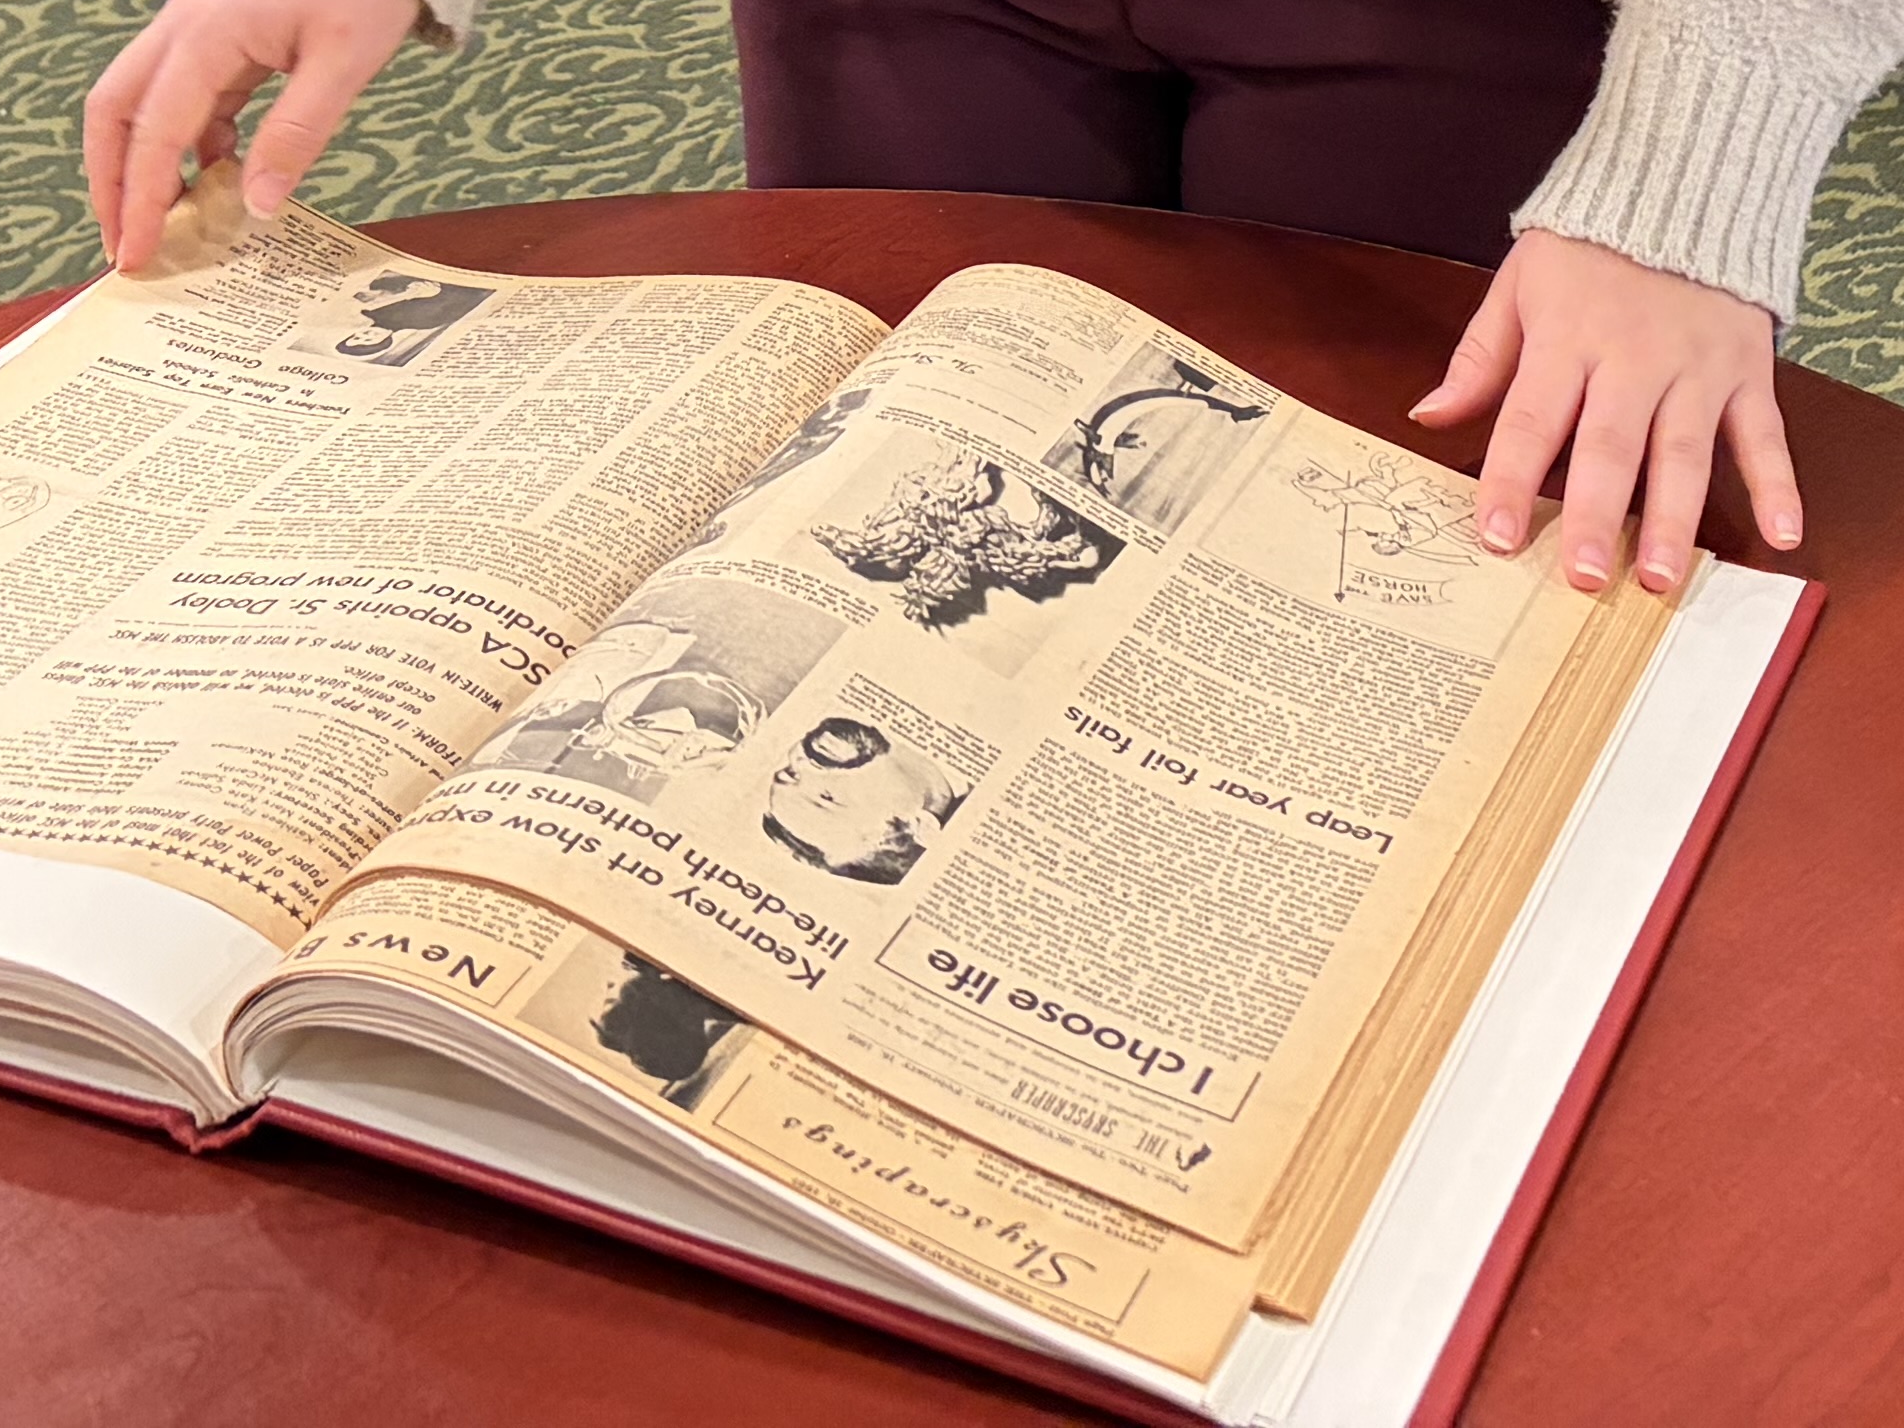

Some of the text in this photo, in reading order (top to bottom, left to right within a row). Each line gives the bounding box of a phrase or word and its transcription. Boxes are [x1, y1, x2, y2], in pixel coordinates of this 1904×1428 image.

[167, 339, 262, 369] Graduates
[97, 356, 156, 377] Salaries
[162, 359, 315, 397] In Catholic Schools
[163, 374, 191, 387] Top
[200, 383, 234, 396] Earn
[285, 400, 351, 415] Teachers
[1351, 570, 1427, 598] HORSE
[1344, 585, 1432, 605] SAVE THE
[172, 572, 577, 660] oordinator of new program
[169, 592, 552, 686] SCA appoints Sr. Dooley
[52, 660, 84, 670] will
[83, 664, 116, 674] PPP
[108, 630, 503, 713] WRITE-IN VOTE FOR PPP IS A VOTE TO ABOLISH THE MSC
[118, 666, 142, 676] the
[141, 668, 161, 677] of
[125, 680, 150, 690] the
[152, 681, 200, 691] abolish
[200, 682, 231, 692] will
[297, 674, 313, 684] is
[314, 676, 351, 690] slate
[344, 666, 436, 703] accept office.
[258, 683, 314, 698] elected,
[316, 691, 333, 702] is
[352, 684, 396, 703] entire
[331, 696, 365, 712] PPP
[396, 701, 422, 715] our
[367, 706, 392, 722] the
[391, 718, 410, 730] If
[484, 780, 521, 795] in
[1064, 706, 1394, 854] Leap year foil fails
[25, 800, 46, 810] of
[48, 802, 86, 814] slate
[86, 805, 123, 816] their
[125, 805, 190, 820] presents
[36, 816, 73, 828] MSC
[75, 819, 101, 829] the
[100, 819, 121, 830] of
[122, 821, 161, 832] most
[190, 814, 234, 836] Party
[526, 786, 683, 852] patterns
[162, 827, 198, 843] that
[198, 837, 234, 854] fact
[235, 830, 284, 857] Power
[237, 850, 263, 868] the
[263, 866, 284, 878] of
[285, 854, 330, 888] Paper
[288, 880, 320, 907] view
[398, 802, 826, 990] Kearney art show expr
[683, 848, 849, 960] life-death
[343, 932, 496, 988] News
[928, 949, 1213, 1095] I choose life
[1133, 1130, 1169, 1160] THE
[782, 1117, 1096, 1286] Skyscrapings
